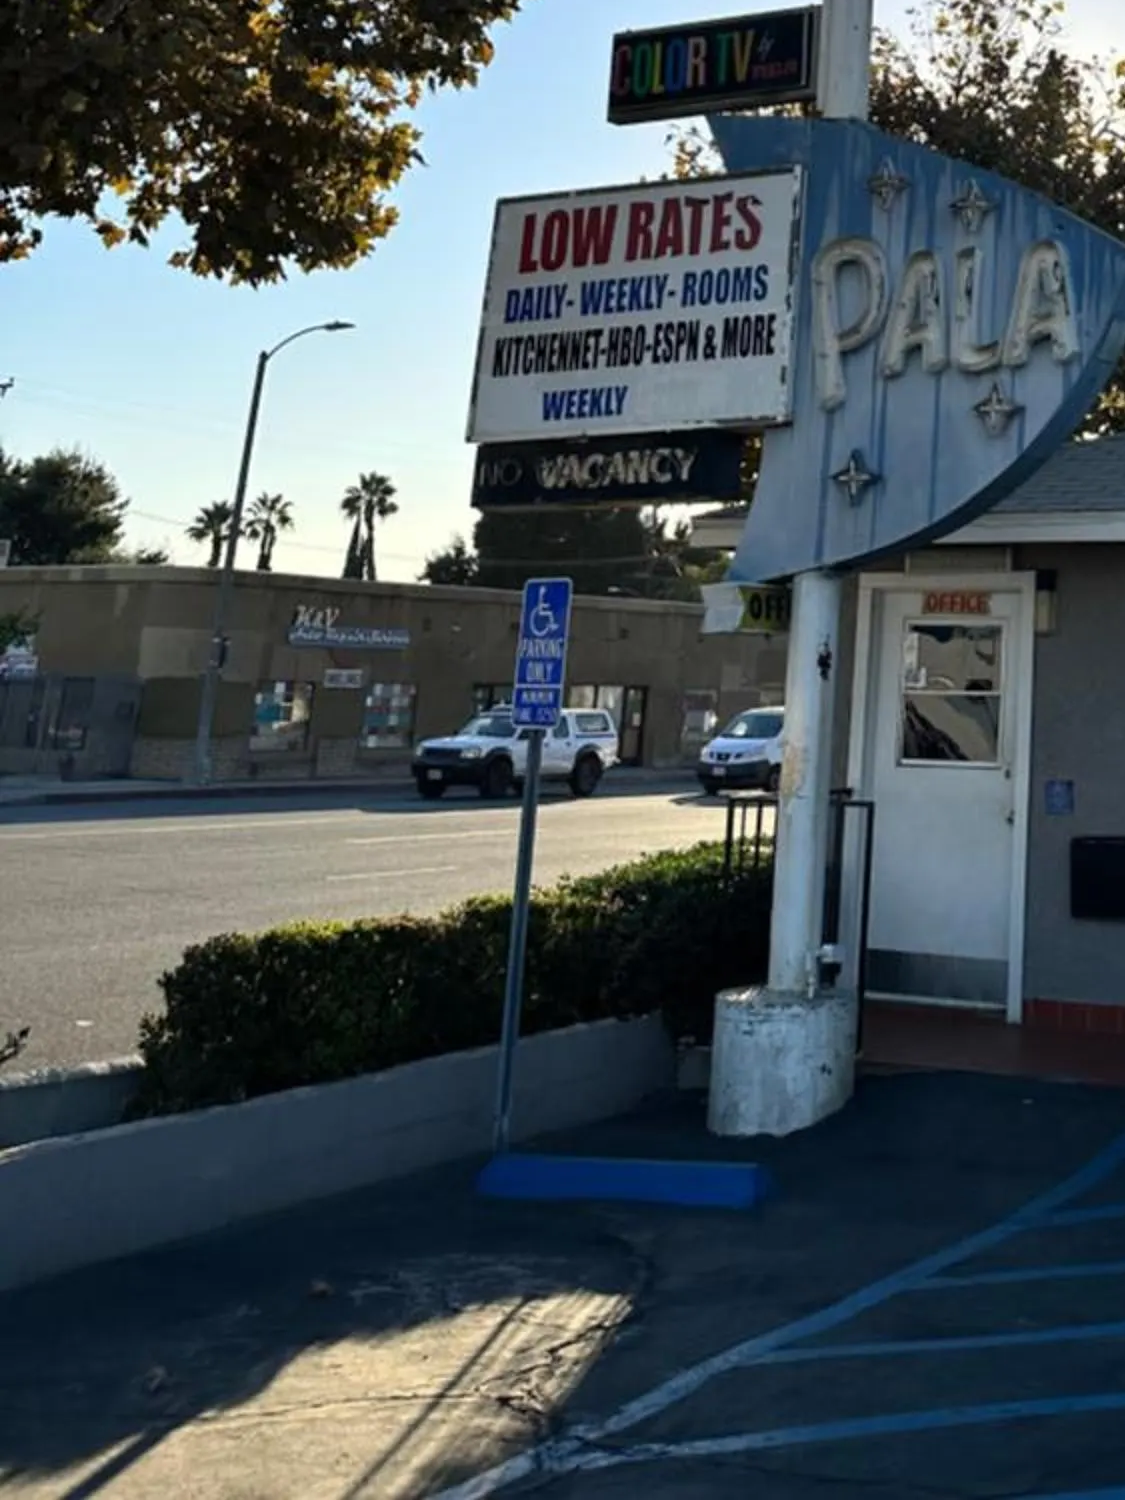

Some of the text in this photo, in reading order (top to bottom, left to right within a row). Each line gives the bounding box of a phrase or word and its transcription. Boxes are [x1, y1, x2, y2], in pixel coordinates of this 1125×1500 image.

[612, 35, 707, 97] COLOR
[716, 28, 755, 85] TV
[518, 191, 763, 275] LOW RATES
[504, 264, 769, 324] DAILY- WEEKLY- ROOMS
[491, 314, 777, 379] KITCHENNET-HBO-ESPN & MORE
[810, 235, 1081, 414] PALA
[542, 386, 629, 422] WEEKLY
[479, 448, 698, 490] NO VACANCY
[926, 591, 991, 614] OFFICE
[519, 637, 564, 658] PARKING
[526, 661, 554, 683] ONLY
